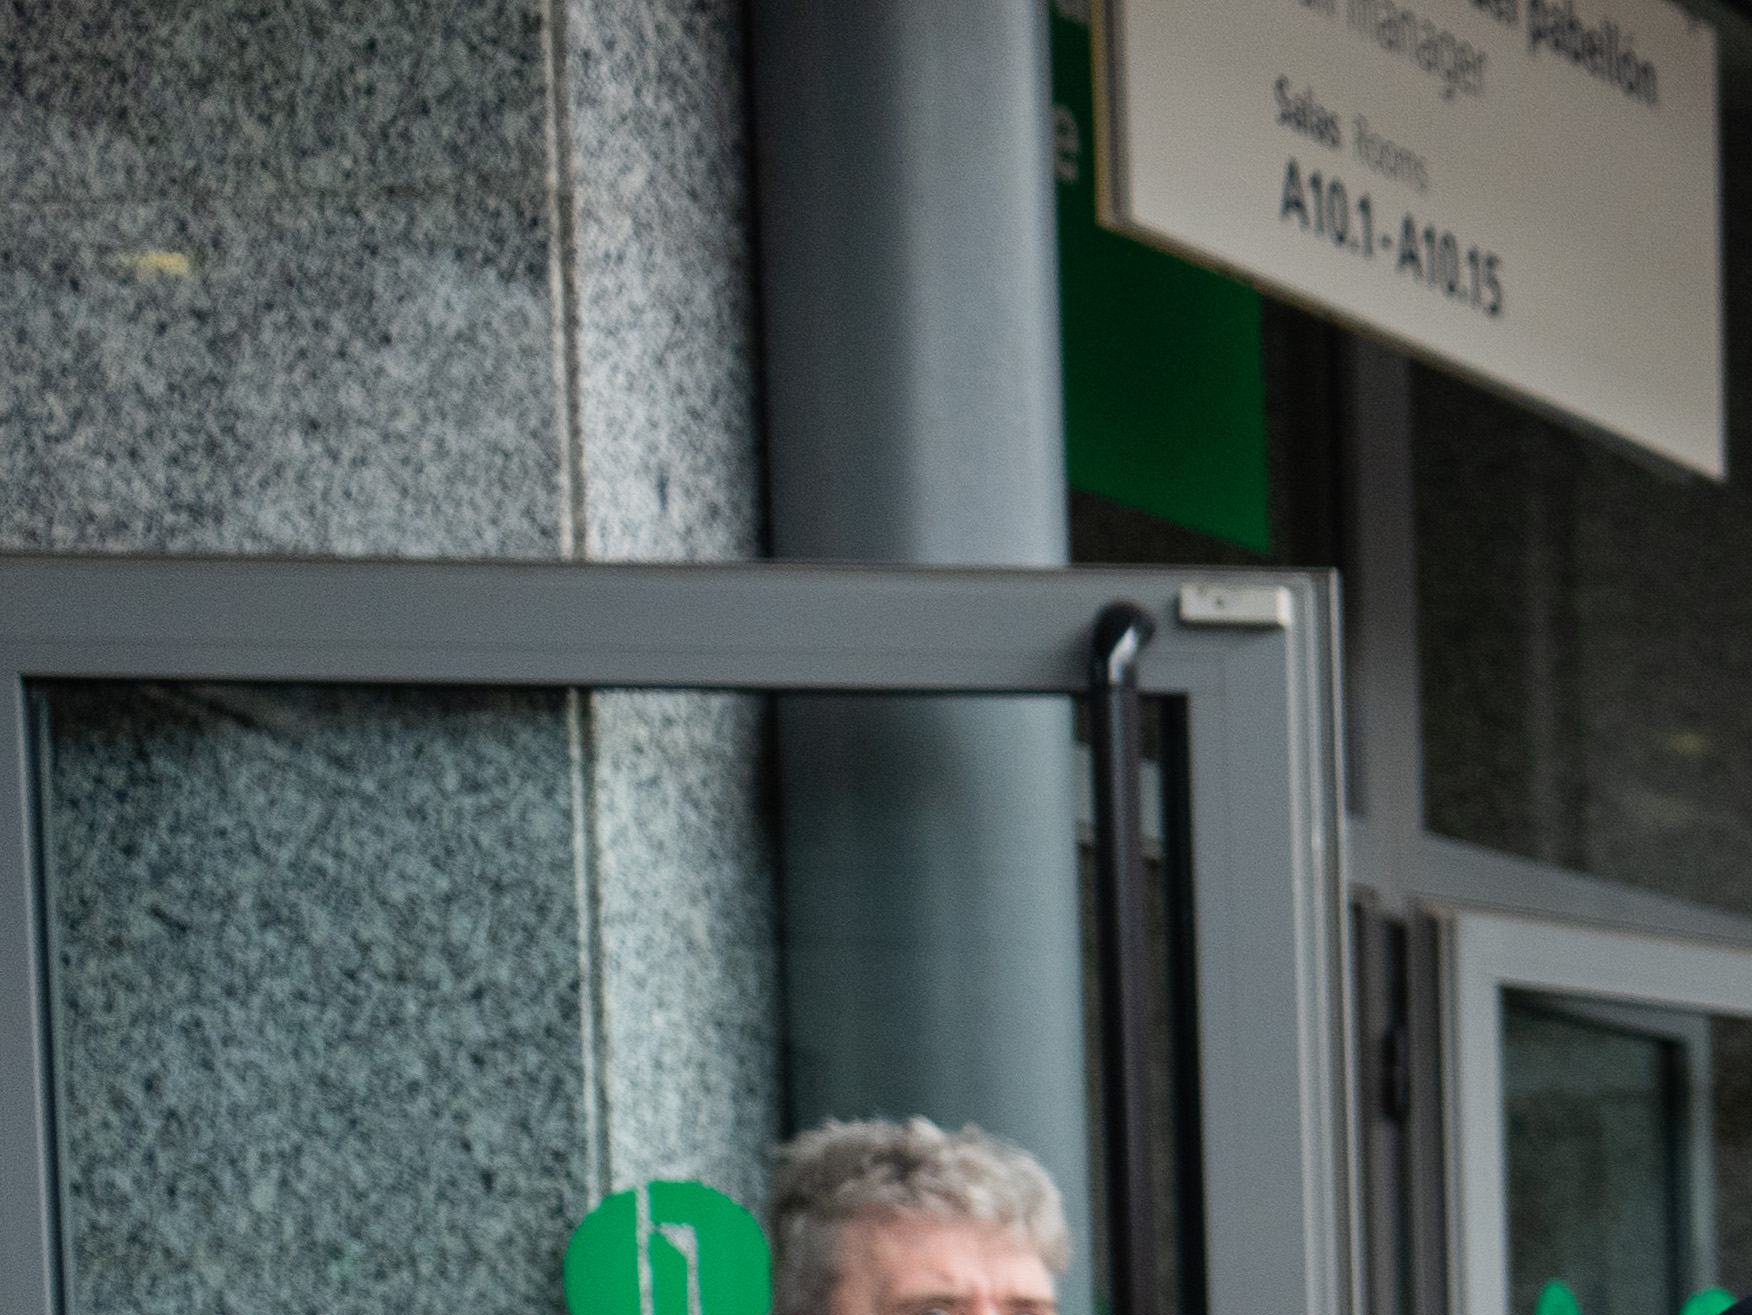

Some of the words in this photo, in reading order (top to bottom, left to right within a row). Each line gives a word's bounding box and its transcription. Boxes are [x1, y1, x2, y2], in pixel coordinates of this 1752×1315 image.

[1346, 0, 1486, 101] manager
[1527, 0, 1658, 106] pabellón
[1274, 74, 1340, 150] Salas
